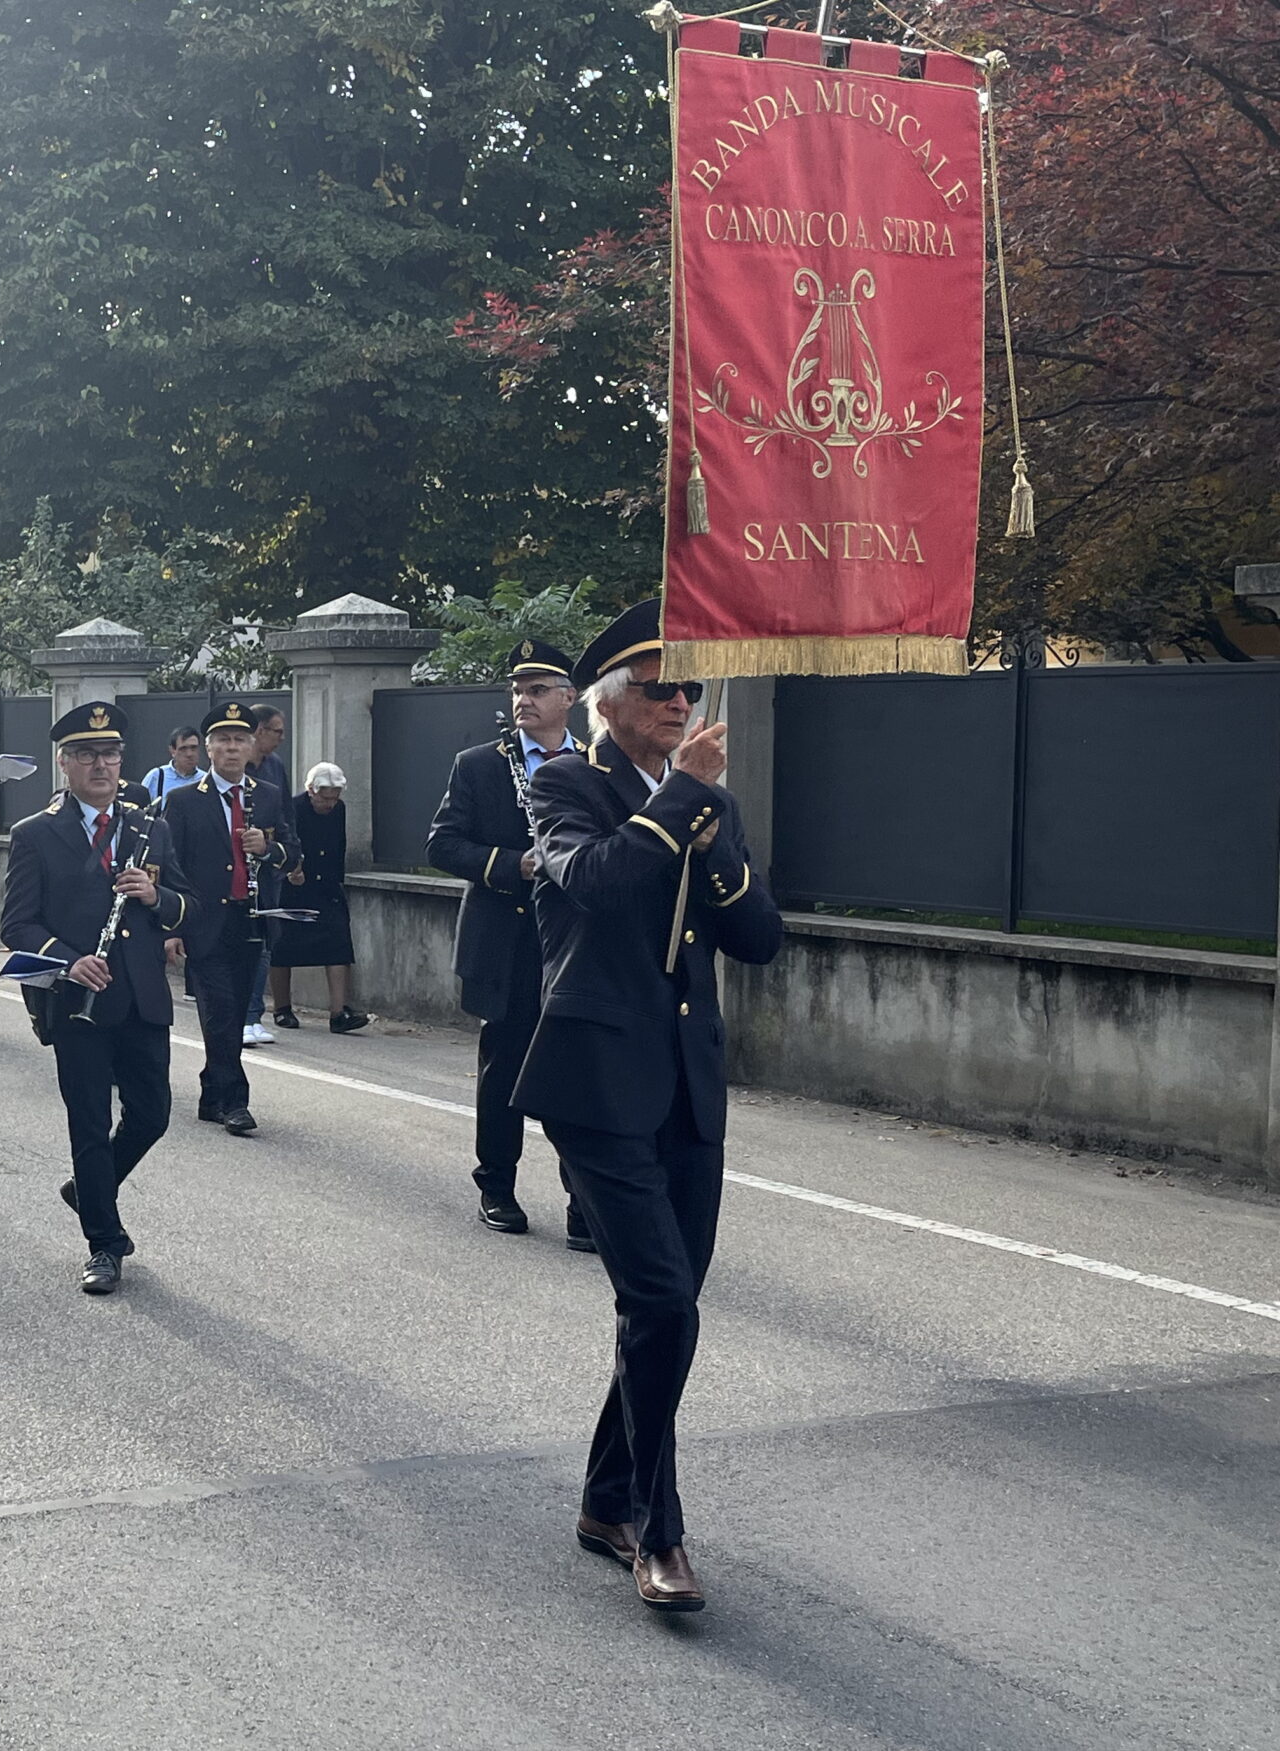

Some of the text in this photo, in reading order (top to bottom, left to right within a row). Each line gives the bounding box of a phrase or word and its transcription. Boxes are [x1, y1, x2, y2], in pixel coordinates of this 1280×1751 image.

[691, 80, 969, 212] BANDA MUSICALE
[882, 216, 956, 257] SERRA
[743, 521, 926, 564] SANTENA
